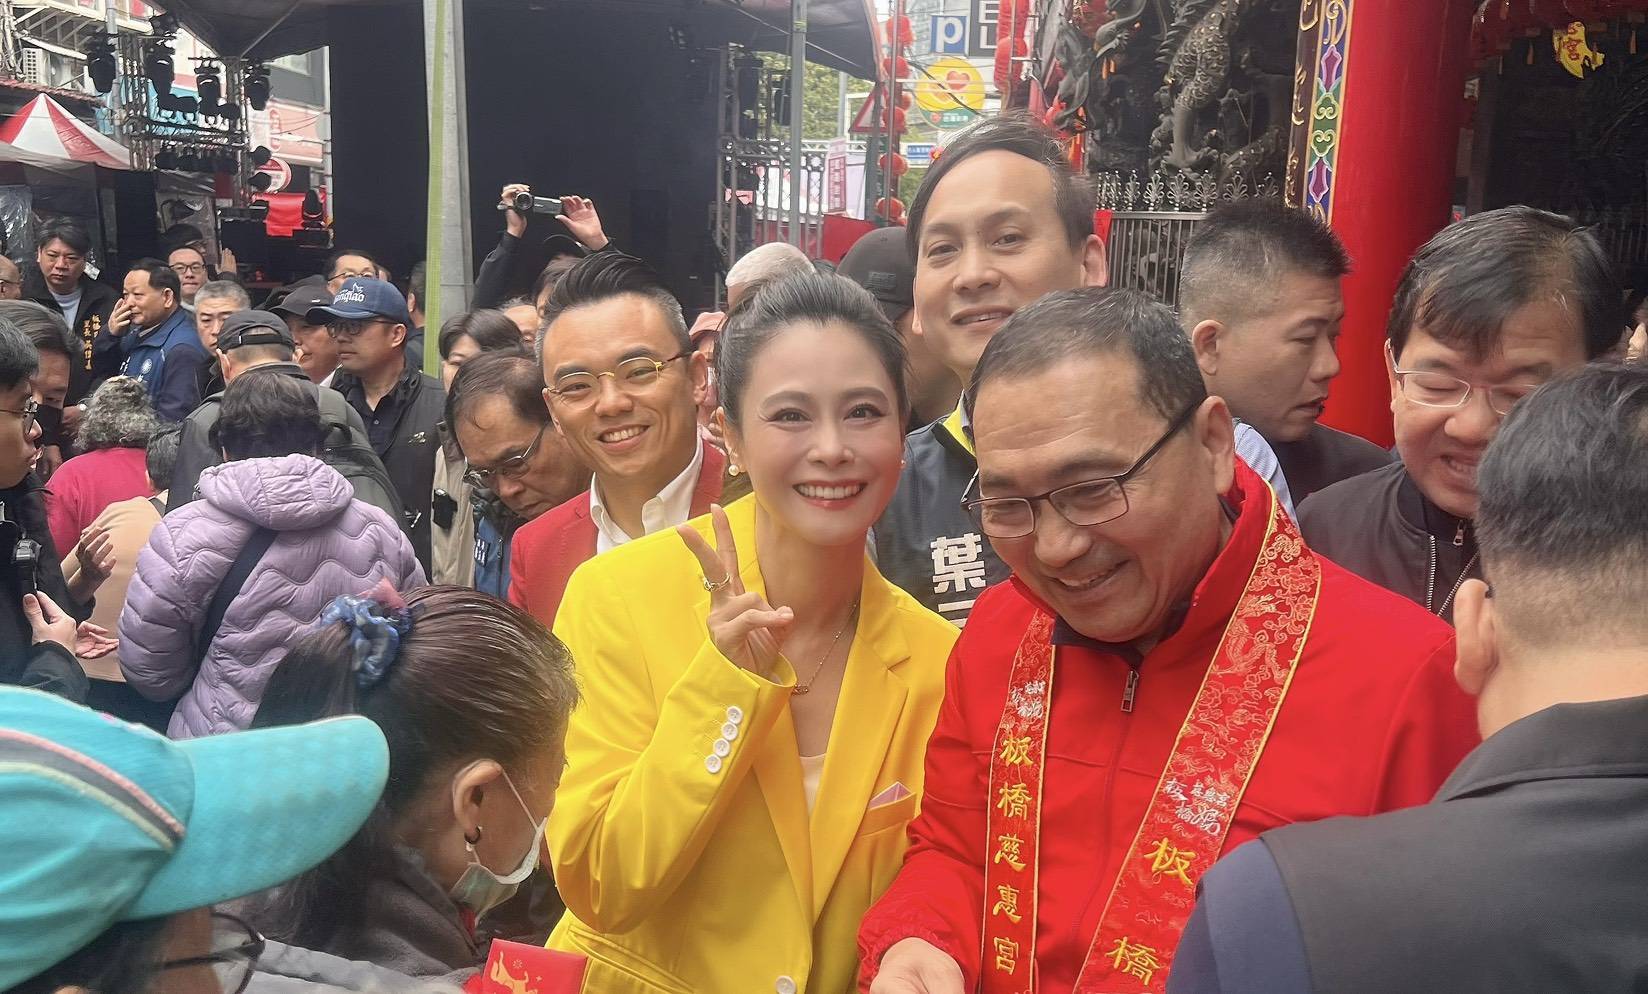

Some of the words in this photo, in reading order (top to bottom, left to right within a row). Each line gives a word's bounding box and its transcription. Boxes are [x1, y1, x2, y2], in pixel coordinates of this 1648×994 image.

[993, 736, 1034, 976] 板橋慈惠宮
[1104, 837, 1196, 985] 板橋
